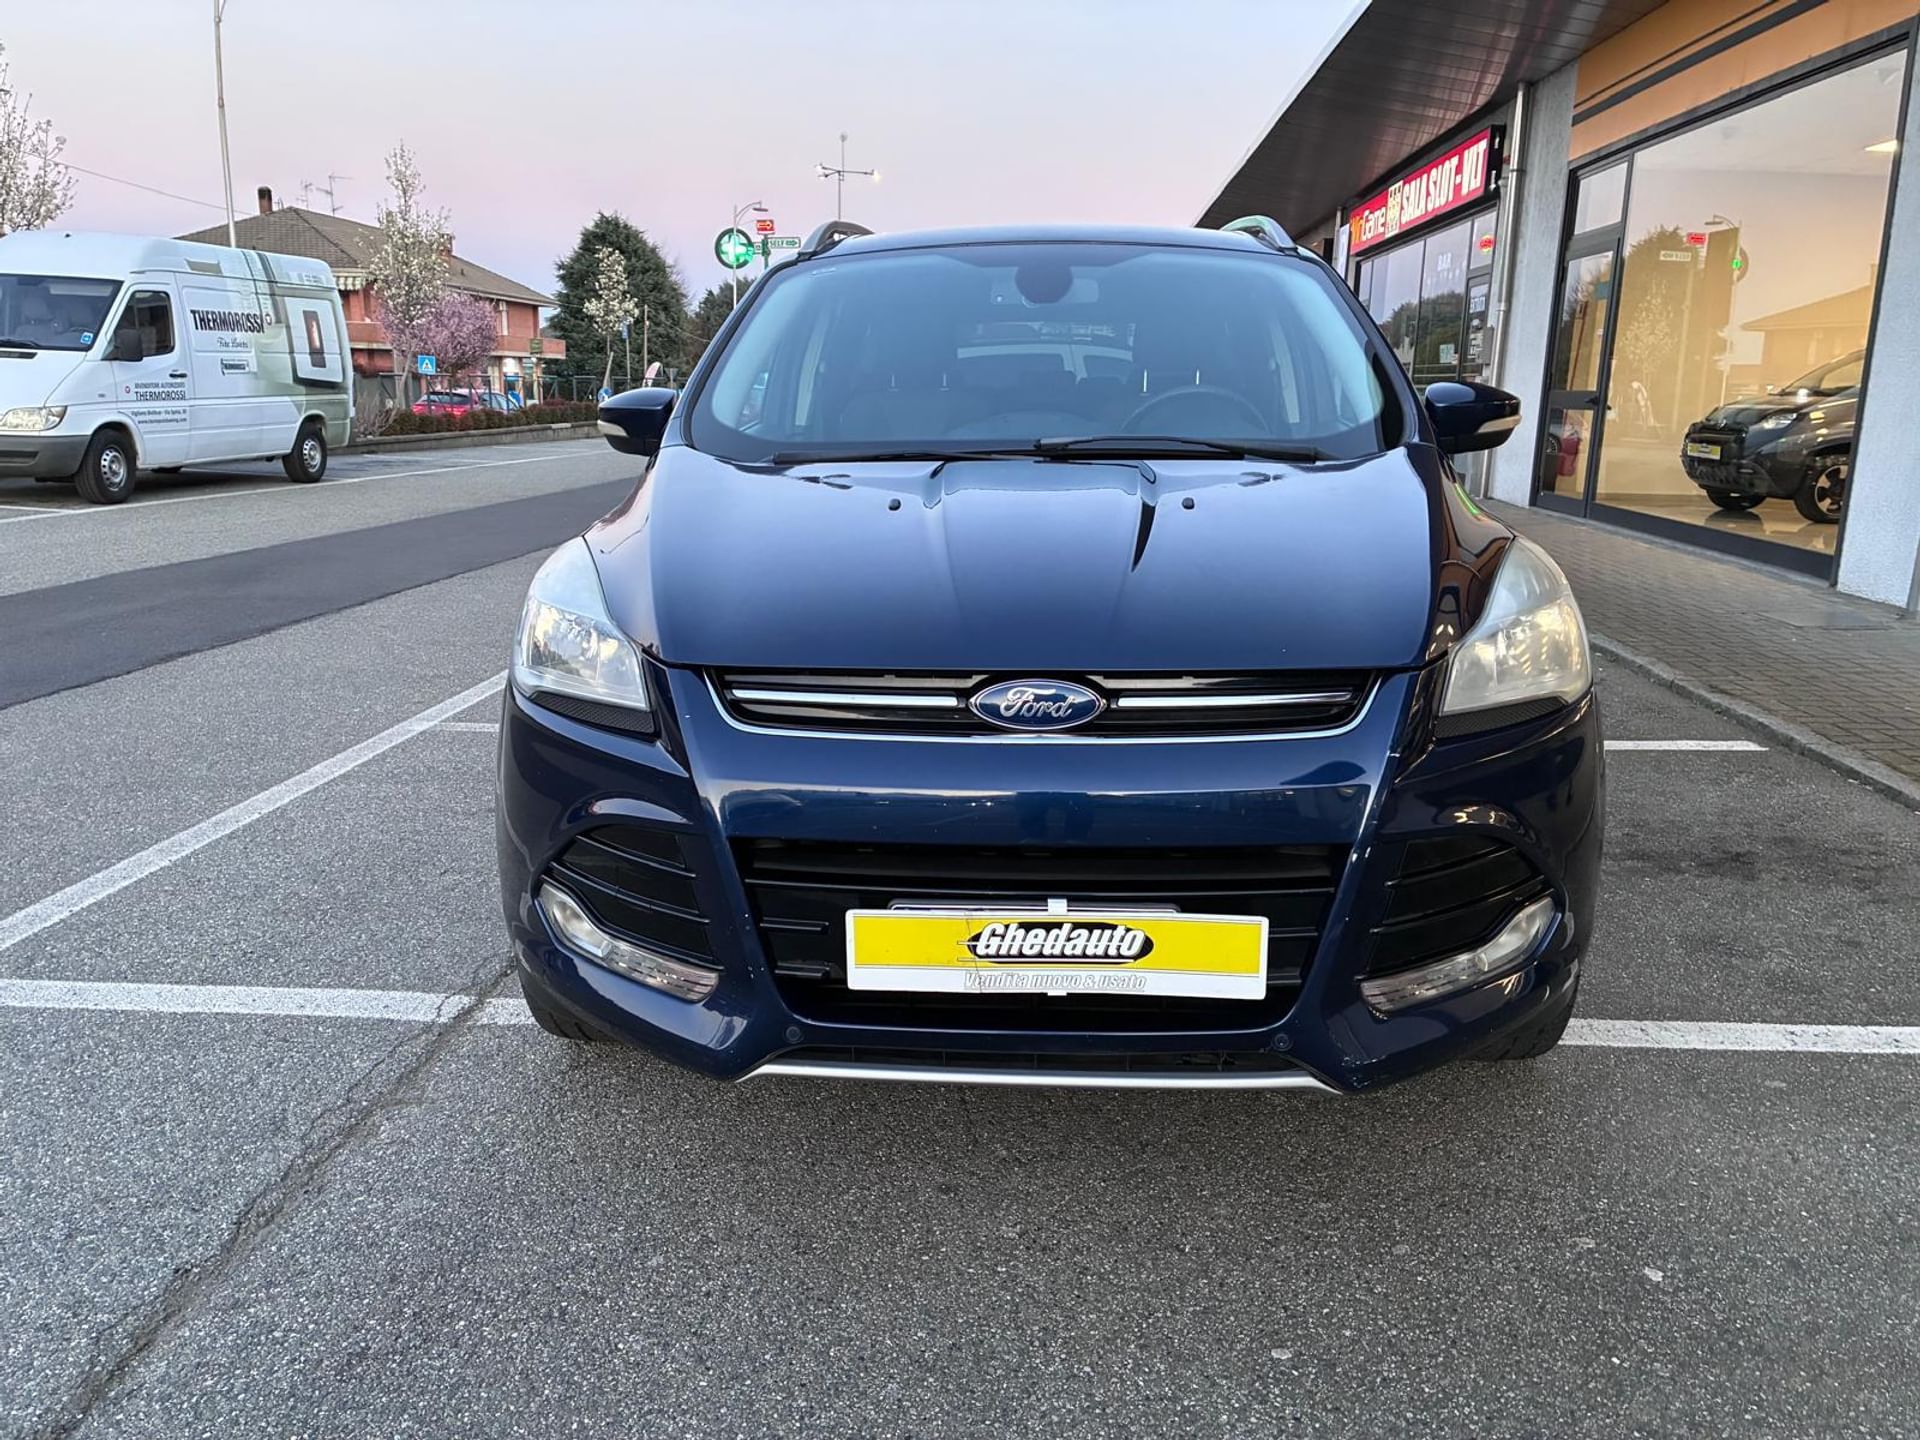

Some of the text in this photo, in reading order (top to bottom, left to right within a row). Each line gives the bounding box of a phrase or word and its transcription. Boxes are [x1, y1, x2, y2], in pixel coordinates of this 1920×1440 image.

[1400, 173, 1428, 224] SALA
[190, 309, 265, 334] THERMOROSSI
[134, 390, 186, 401] THERMOROSSI
[999, 686, 1074, 718] Ford
[975, 921, 1146, 957] Ghedauto
[964, 971, 1146, 992] Vendita nuovo & usato
